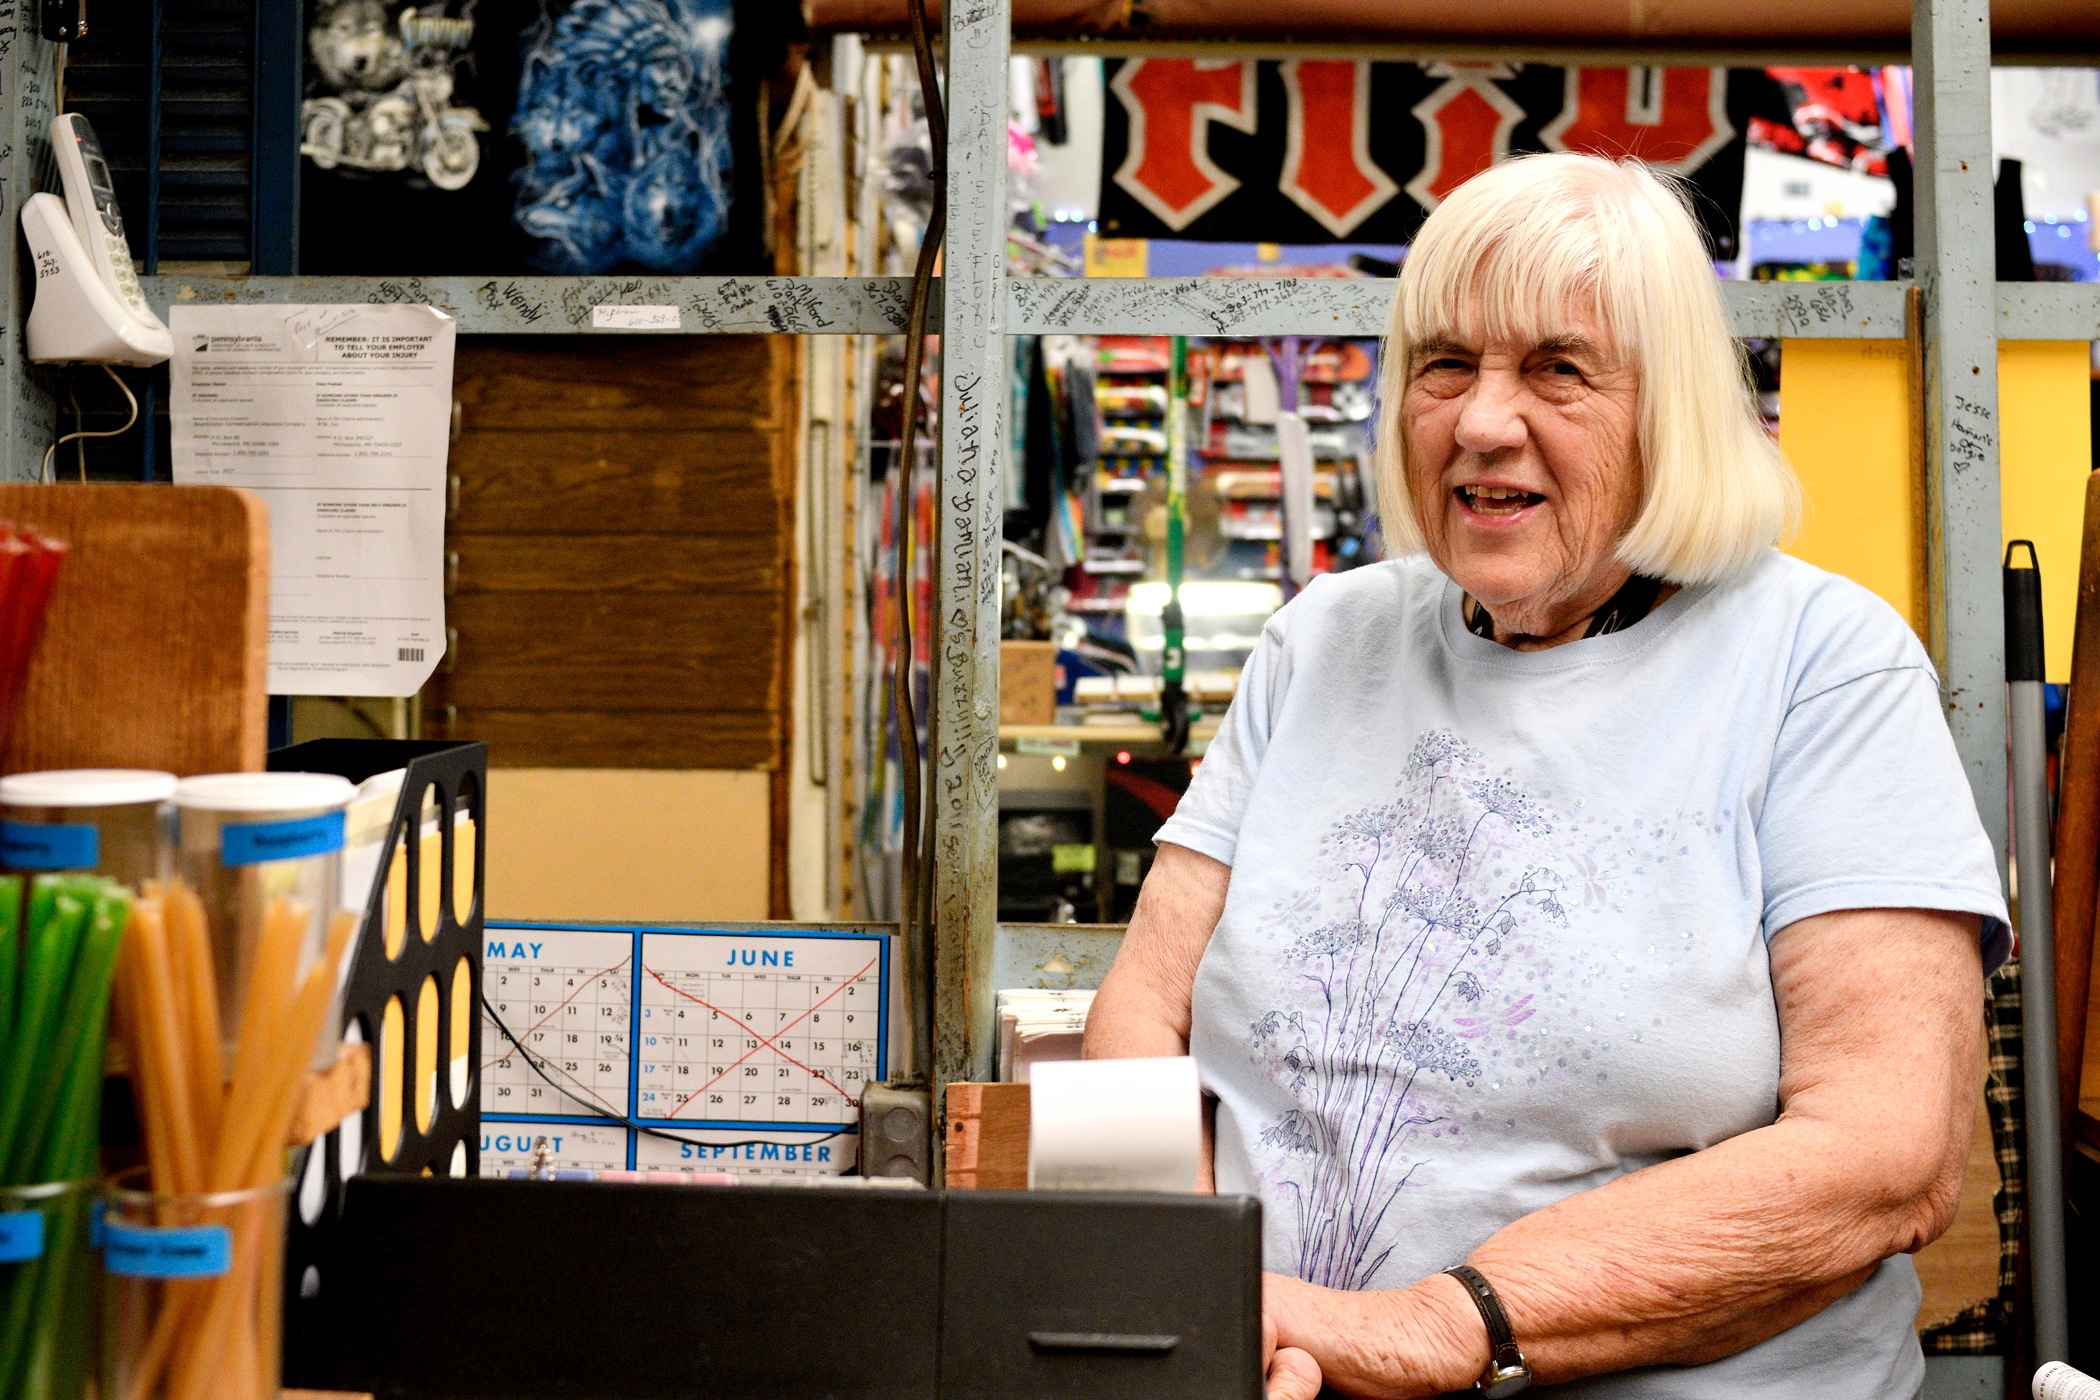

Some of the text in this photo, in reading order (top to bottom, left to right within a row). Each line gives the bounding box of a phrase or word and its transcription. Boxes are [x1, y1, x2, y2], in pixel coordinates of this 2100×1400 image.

[503, 282, 543, 325] Wendy
[1954, 395, 1991, 419] Jesse
[954, 373, 981, 486] Juliana
[487, 942, 543, 959] MAY
[727, 949, 794, 967] JUNE
[501, 976, 507, 984] 2
[534, 978, 540, 986] 3
[601, 980, 608, 988] 5
[815, 986, 855, 995] 1 2
[500, 1004, 612, 1016] 9 10 11 12
[644, 1009, 854, 1023] 3 4 5 6 7 8 9
[533, 1033, 544, 1041] 17
[567, 1034, 578, 1042] 18
[601, 1035, 611, 1044] 19
[644, 1037, 858, 1051] 10 11 12 13 14 15 16
[500, 1060, 511, 1068] 23
[566, 1062, 578, 1070] 25
[599, 1063, 612, 1072] 26
[644, 1065, 859, 1079] 17 18 19 20 21 22 23
[498, 1087, 542, 1097] 30 31
[642, 1093, 859, 1107] 24 25 26 27 28 29 30
[680, 1141, 832, 1163] SEPTEMBER
